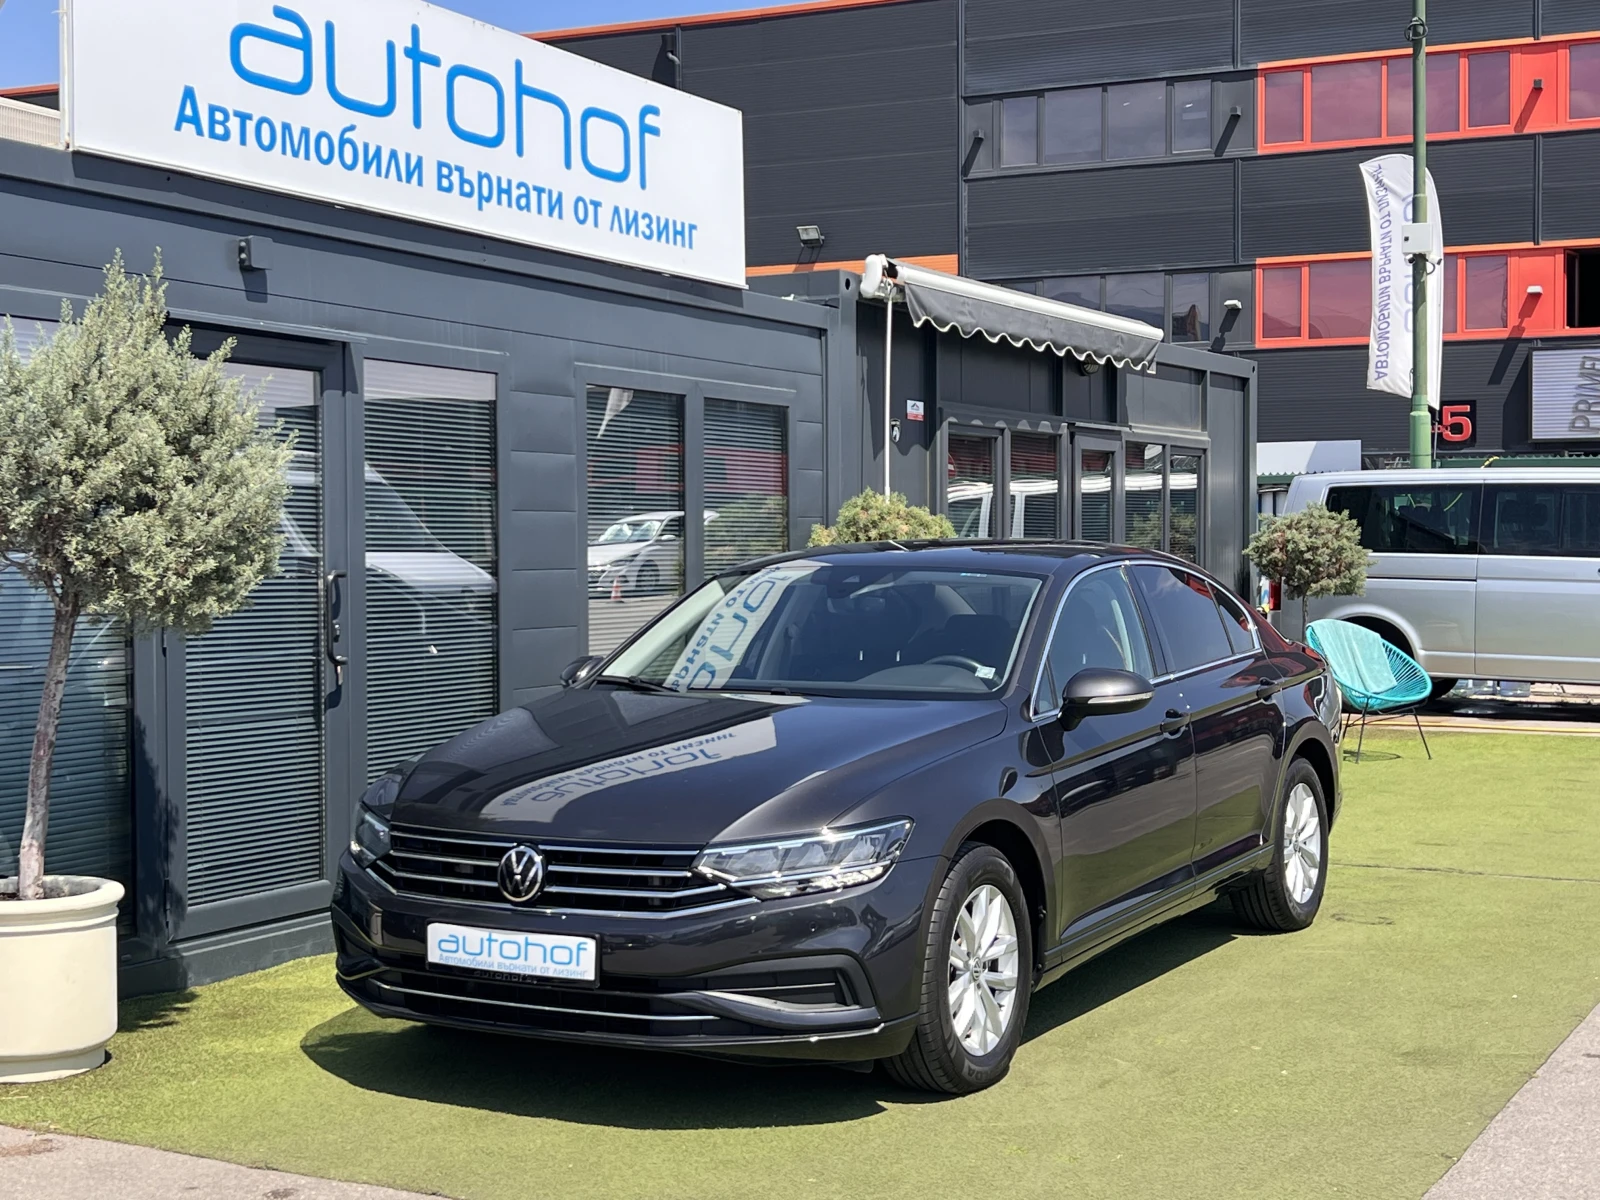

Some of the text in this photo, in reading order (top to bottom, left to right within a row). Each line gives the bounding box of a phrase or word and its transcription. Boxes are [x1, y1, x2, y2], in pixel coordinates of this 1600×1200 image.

[230, 6, 661, 190] autohof
[175, 86, 697, 249] Автомобили върнати от лизинг
[1443, 405, 1472, 442] 5
[438, 932, 588, 967] autohof
[438, 953, 588, 978] Автомобили върнати от лизинг
